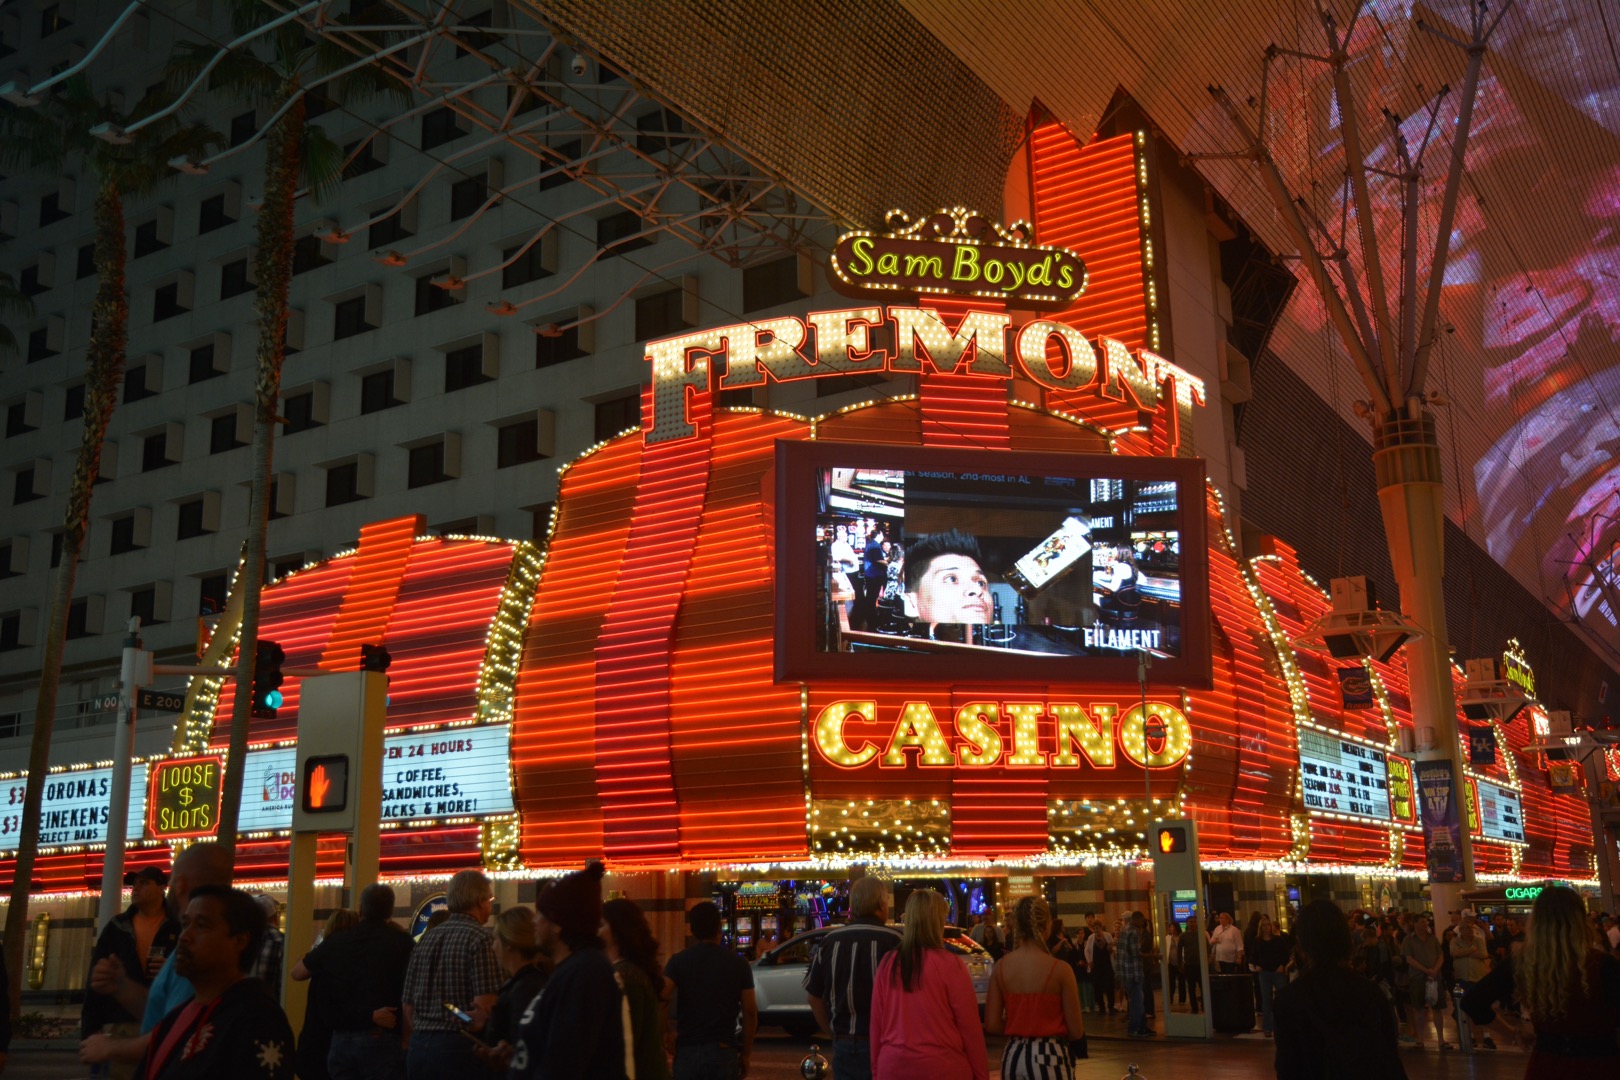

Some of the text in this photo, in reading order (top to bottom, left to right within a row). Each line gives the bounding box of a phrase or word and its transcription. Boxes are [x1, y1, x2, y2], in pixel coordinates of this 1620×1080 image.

[849, 237, 1074, 292] Sam Boyd's
[644, 306, 1206, 456] FREMONT
[1007, 475, 1016, 483] in
[1018, 476, 1031, 484] AL
[1089, 516, 1113, 528] AMENT
[1084, 628, 1160, 649] FILAMENT
[144, 694, 182, 709] E 200
[813, 700, 1192, 770] CASINO
[408, 744, 424, 757] 24
[431, 739, 473, 756] HOURS
[162, 763, 214, 792] LOOSE
[396, 767, 447, 784] COFFEE,
[46, 777, 109, 802] ORONAS
[178, 786, 194, 807] $
[382, 782, 464, 801] SANDWICHES,
[160, 803, 210, 831] SLOTS
[382, 798, 477, 818] ACKS & MORE!
[2, 805, 110, 835] $3 EINEKENS
[38, 828, 98, 844] SELECT BARS
